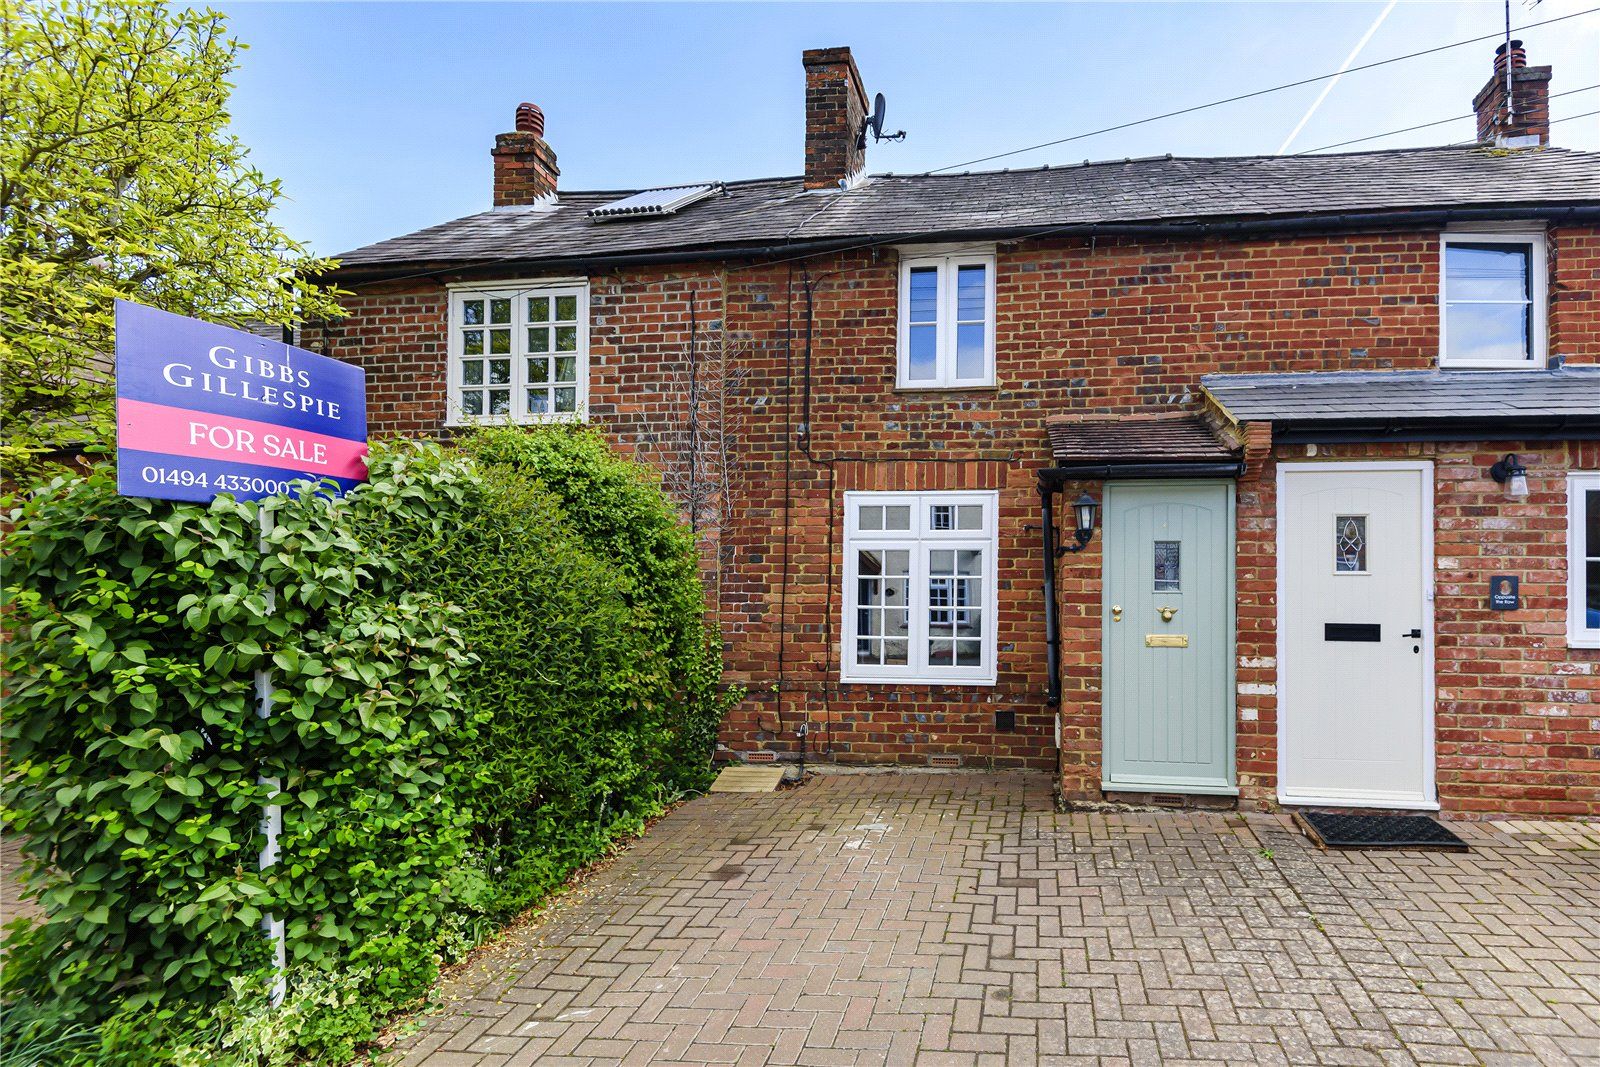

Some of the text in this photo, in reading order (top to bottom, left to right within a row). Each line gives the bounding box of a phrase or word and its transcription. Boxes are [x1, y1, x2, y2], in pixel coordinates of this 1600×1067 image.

[208, 345, 311, 388] GIBBS
[162, 363, 341, 420] GILLESPIE
[189, 421, 328, 465] FOR SALE
[141, 466, 290, 496] 01494 433000
